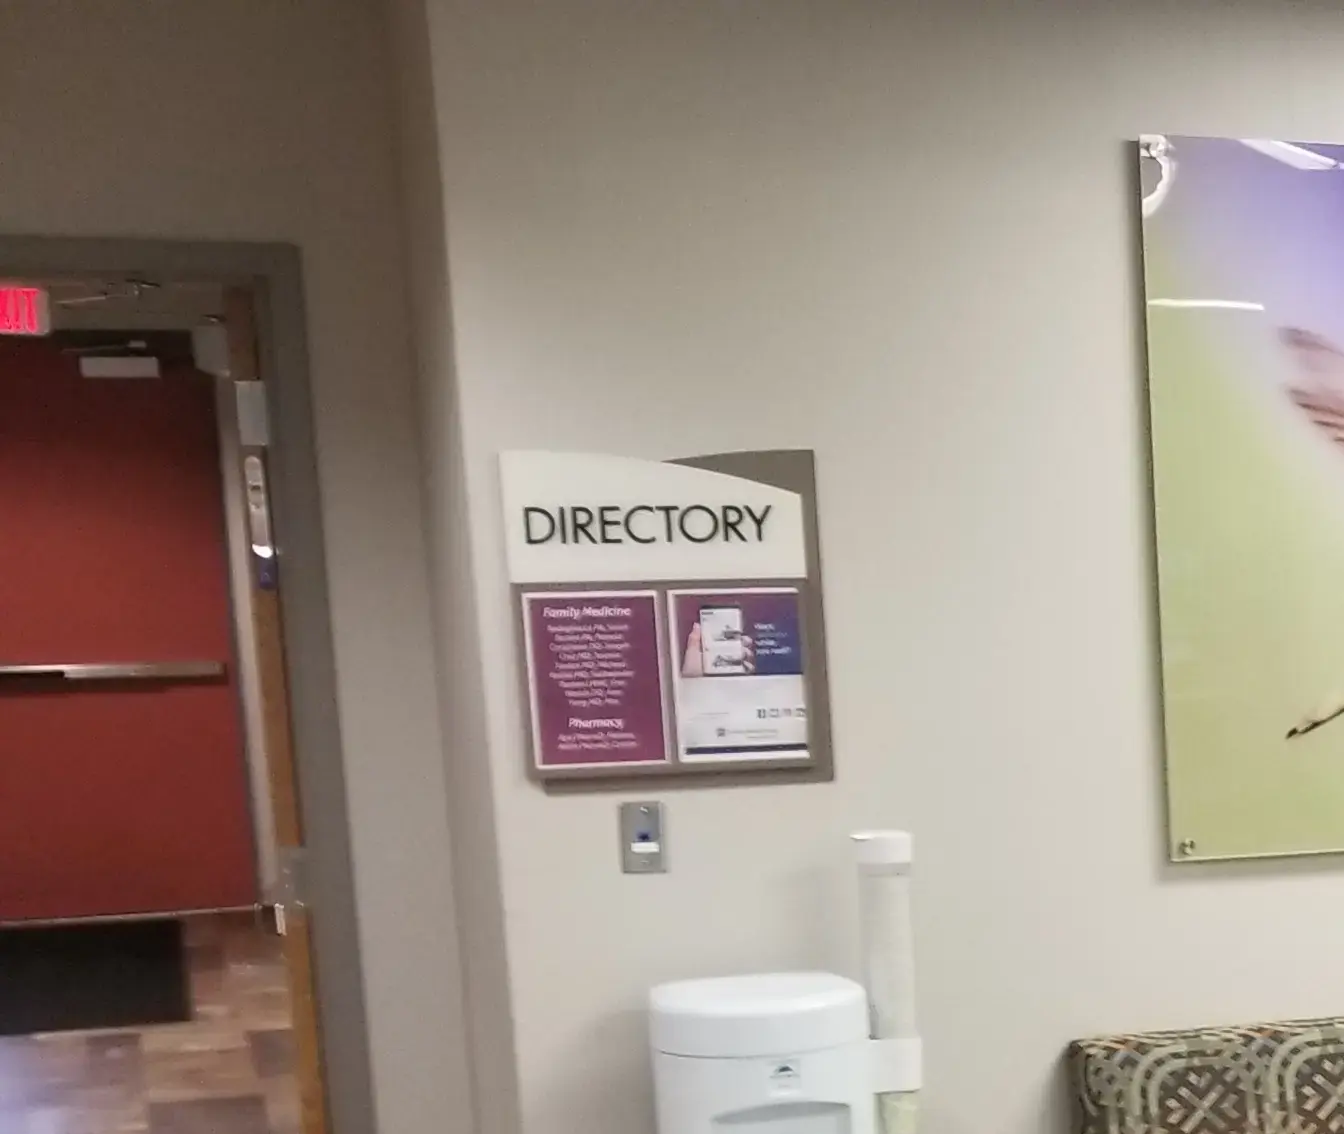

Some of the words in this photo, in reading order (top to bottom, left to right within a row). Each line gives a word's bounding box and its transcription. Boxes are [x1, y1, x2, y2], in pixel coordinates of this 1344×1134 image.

[523, 504, 772, 544] DIRECTORY
[543, 606, 580, 619] Family
[581, 606, 632, 616] Medicine
[568, 717, 624, 729] Pharmacy
